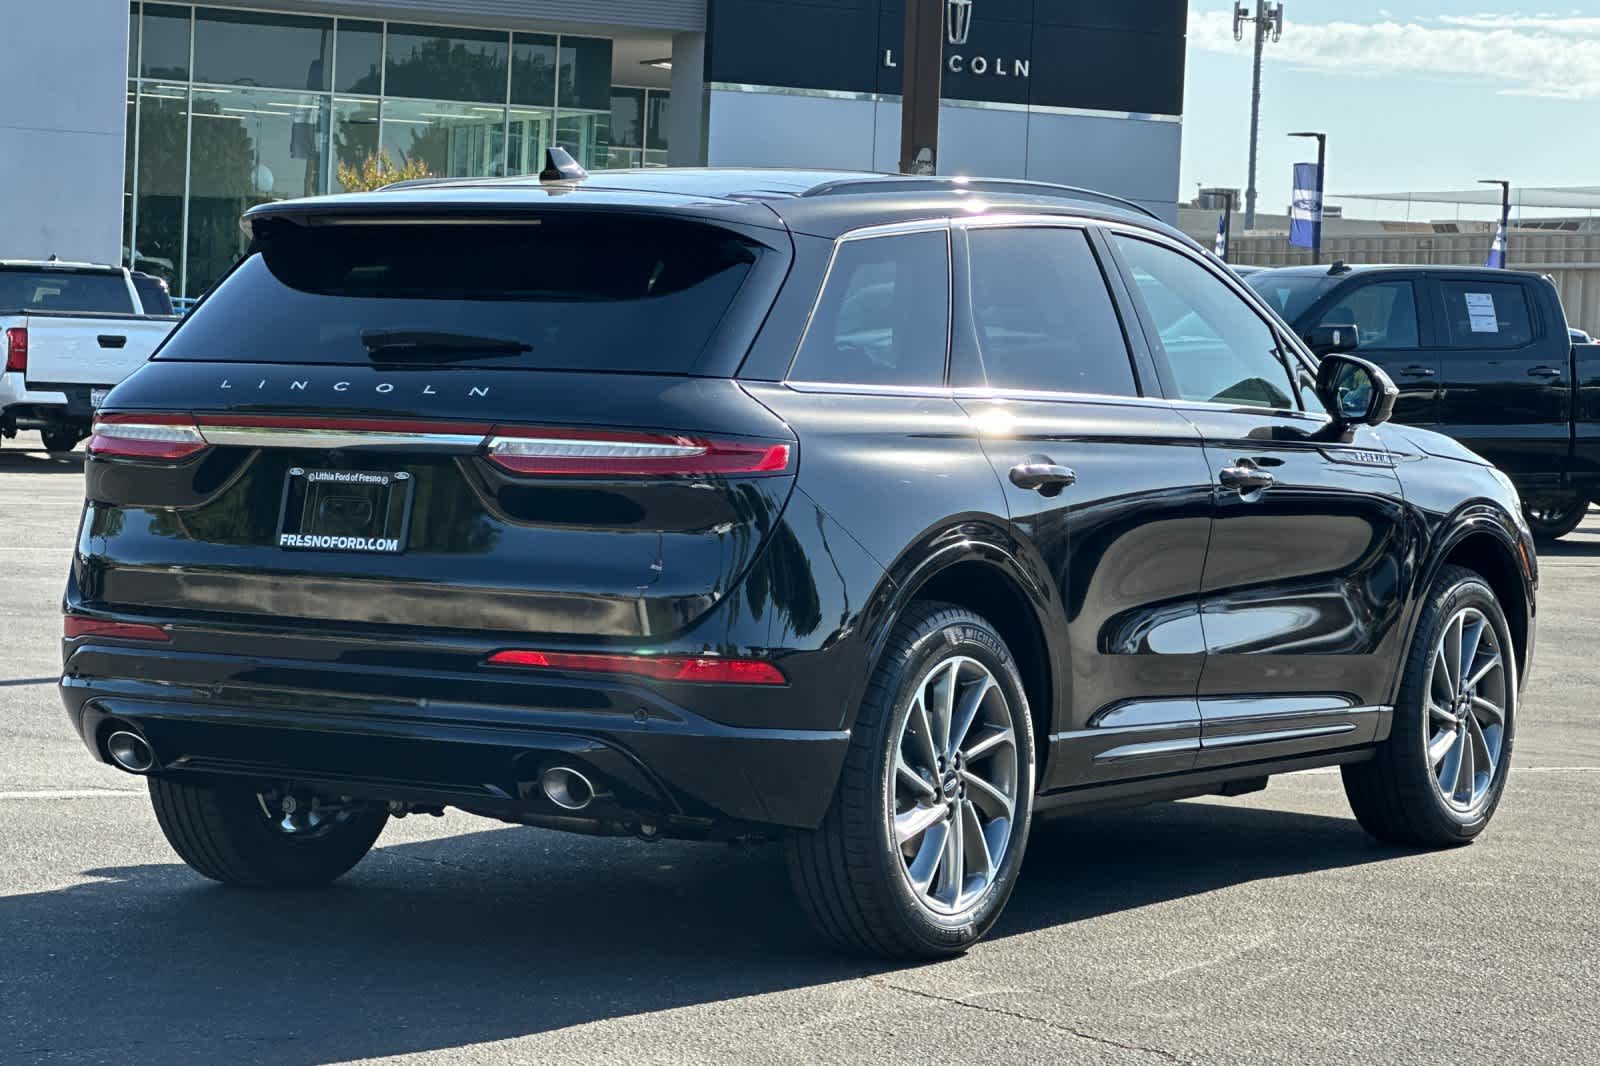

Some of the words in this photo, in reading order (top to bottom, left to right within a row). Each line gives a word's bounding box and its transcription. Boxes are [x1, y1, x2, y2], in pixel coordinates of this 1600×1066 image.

[885, 49, 1030, 77] LCOLN
[220, 379, 490, 397] LINCOLN
[335, 472, 350, 482] Ford
[351, 473, 359, 482] of
[359, 473, 382, 483] Fresno
[280, 534, 398, 551] FRESNOFORD.COM
